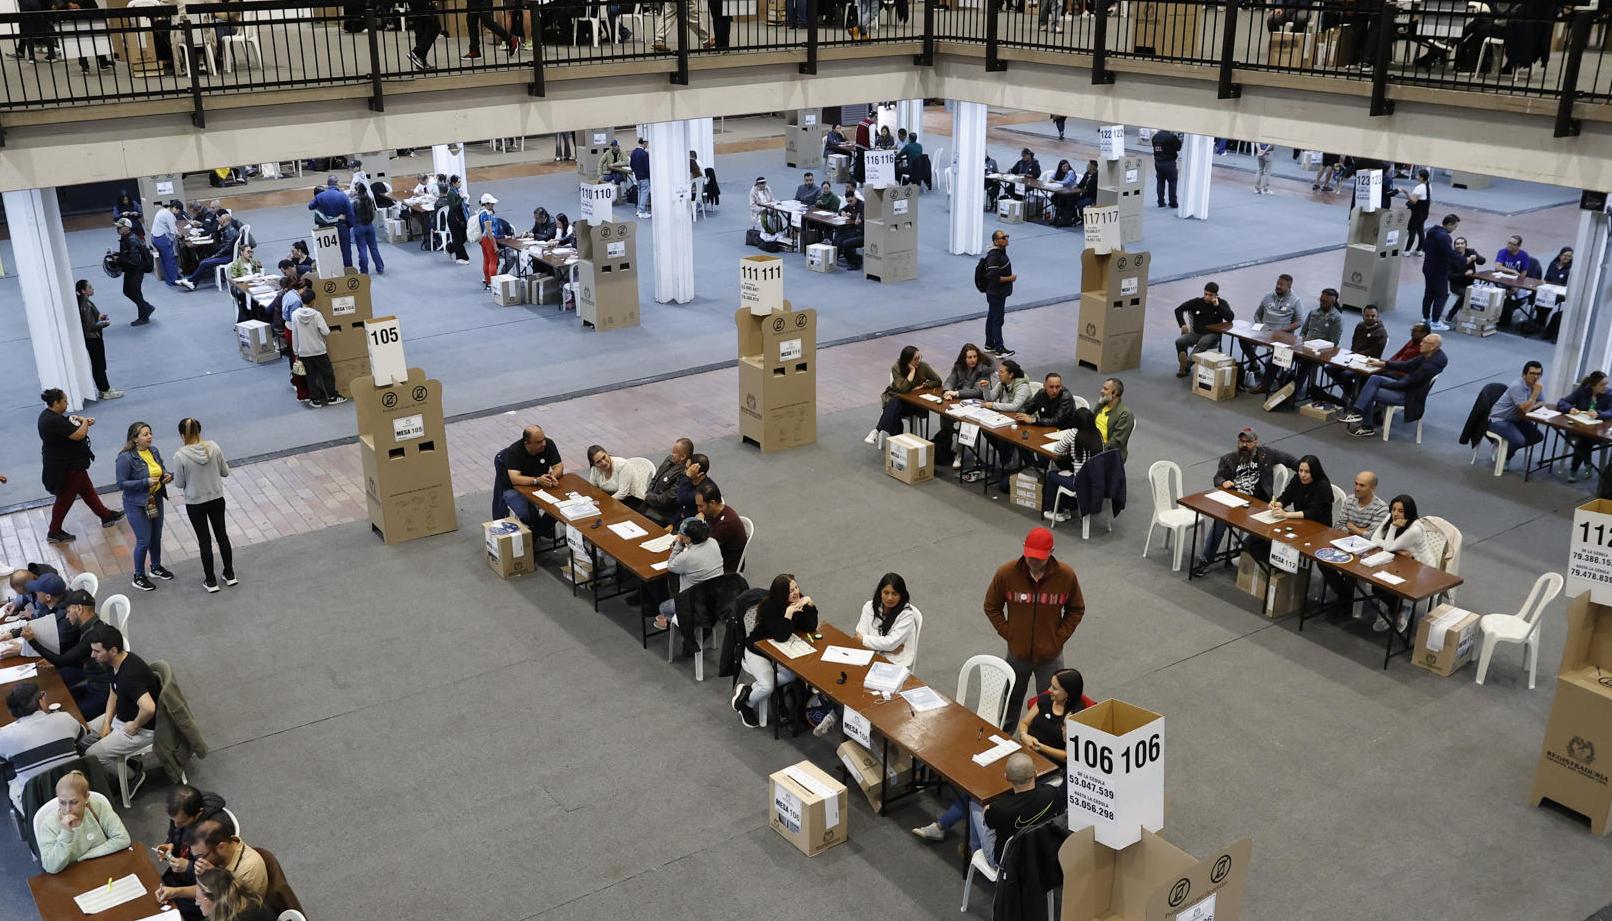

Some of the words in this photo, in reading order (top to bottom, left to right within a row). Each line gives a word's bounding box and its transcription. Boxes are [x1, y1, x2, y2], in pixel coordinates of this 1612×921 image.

[1101, 130, 1112, 139] 122
[866, 156, 879, 165] 116
[880, 154, 894, 164] 116
[1357, 175, 1370, 186] 123
[582, 187, 593, 200] 110
[594, 188, 611, 200] 110
[1084, 212, 1100, 225] 117
[1102, 210, 1119, 224] 117
[316, 234, 338, 249] 104
[742, 265, 758, 281] 111
[762, 265, 781, 281] 111
[371, 327, 399, 346] 105
[396, 429, 410, 437] MESA
[412, 426, 423, 434] 105
[1271, 553, 1285, 565] MESA
[1285, 559, 1296, 569] 112
[1573, 552, 1612, 567] 79.388.15
[844, 722, 858, 735] MESA
[1069, 735, 1114, 775] 106
[1121, 734, 1160, 774] 106
[1069, 774, 1114, 800] 53.047.539
[776, 798, 789, 813] MESA
[790, 809, 800, 821] 106
[1069, 795, 1114, 820] 53.056.298
